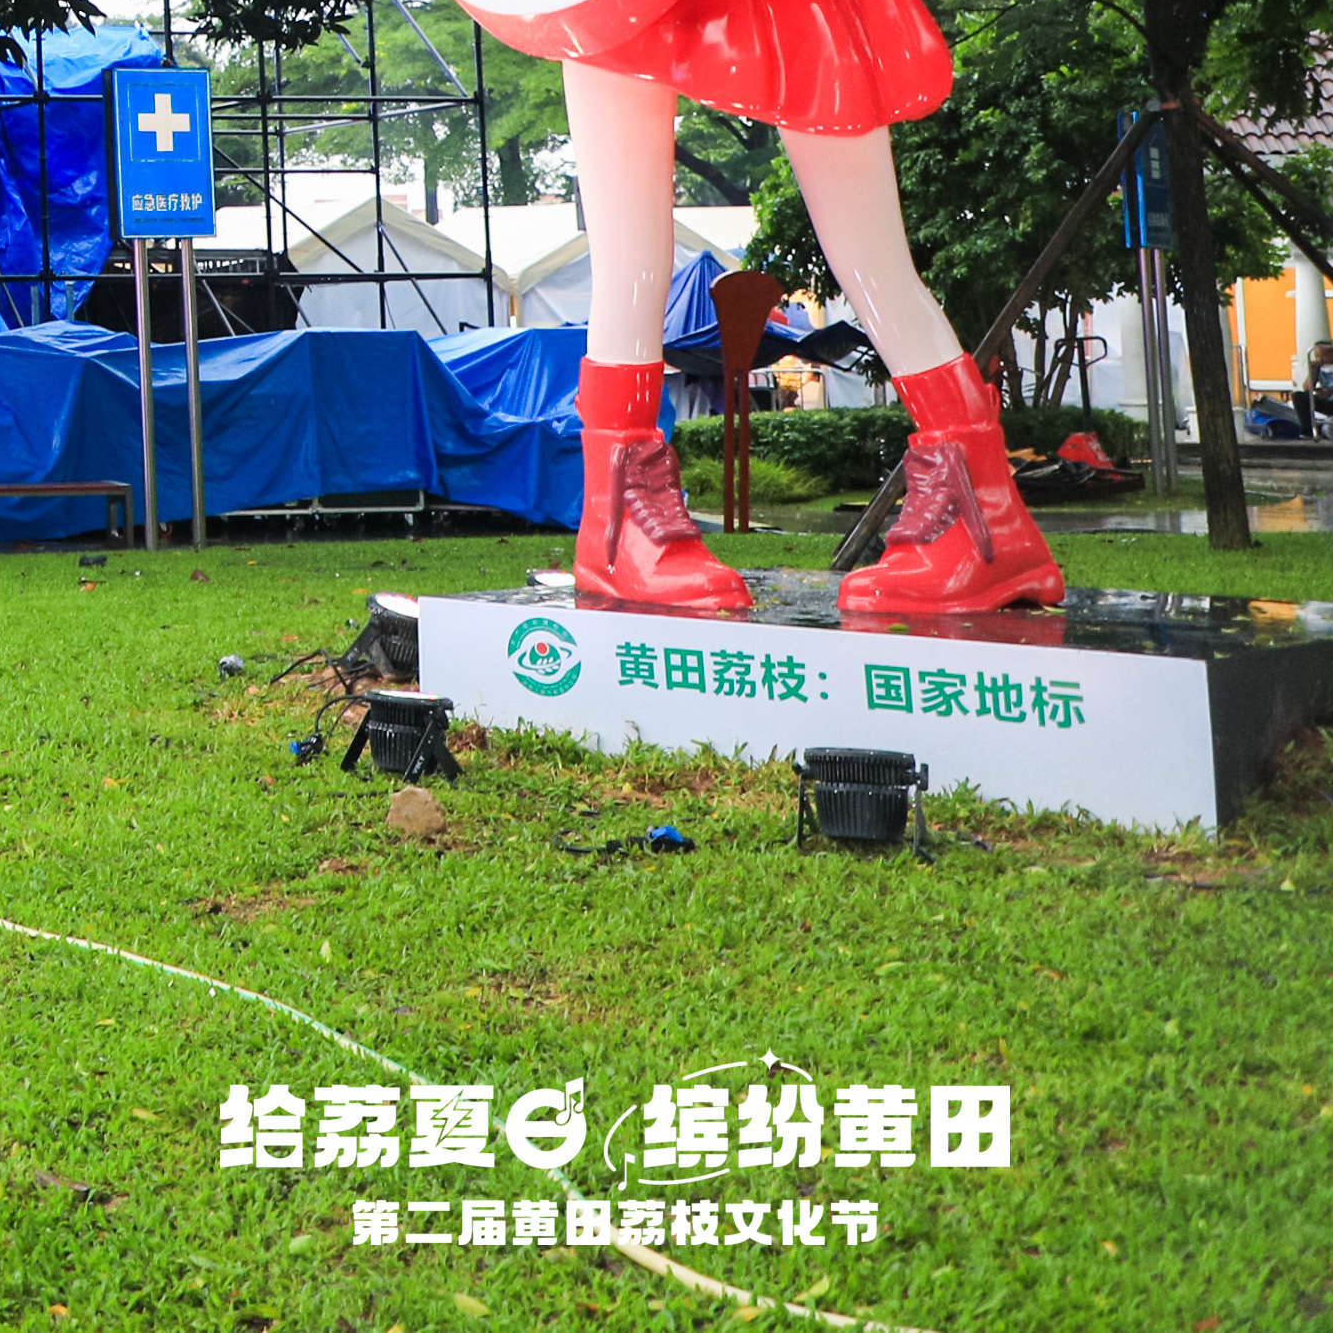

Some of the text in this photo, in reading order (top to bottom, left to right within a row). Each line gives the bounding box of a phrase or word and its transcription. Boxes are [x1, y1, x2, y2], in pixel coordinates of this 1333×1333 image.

[131, 193, 203, 212] 应急医疗救护
